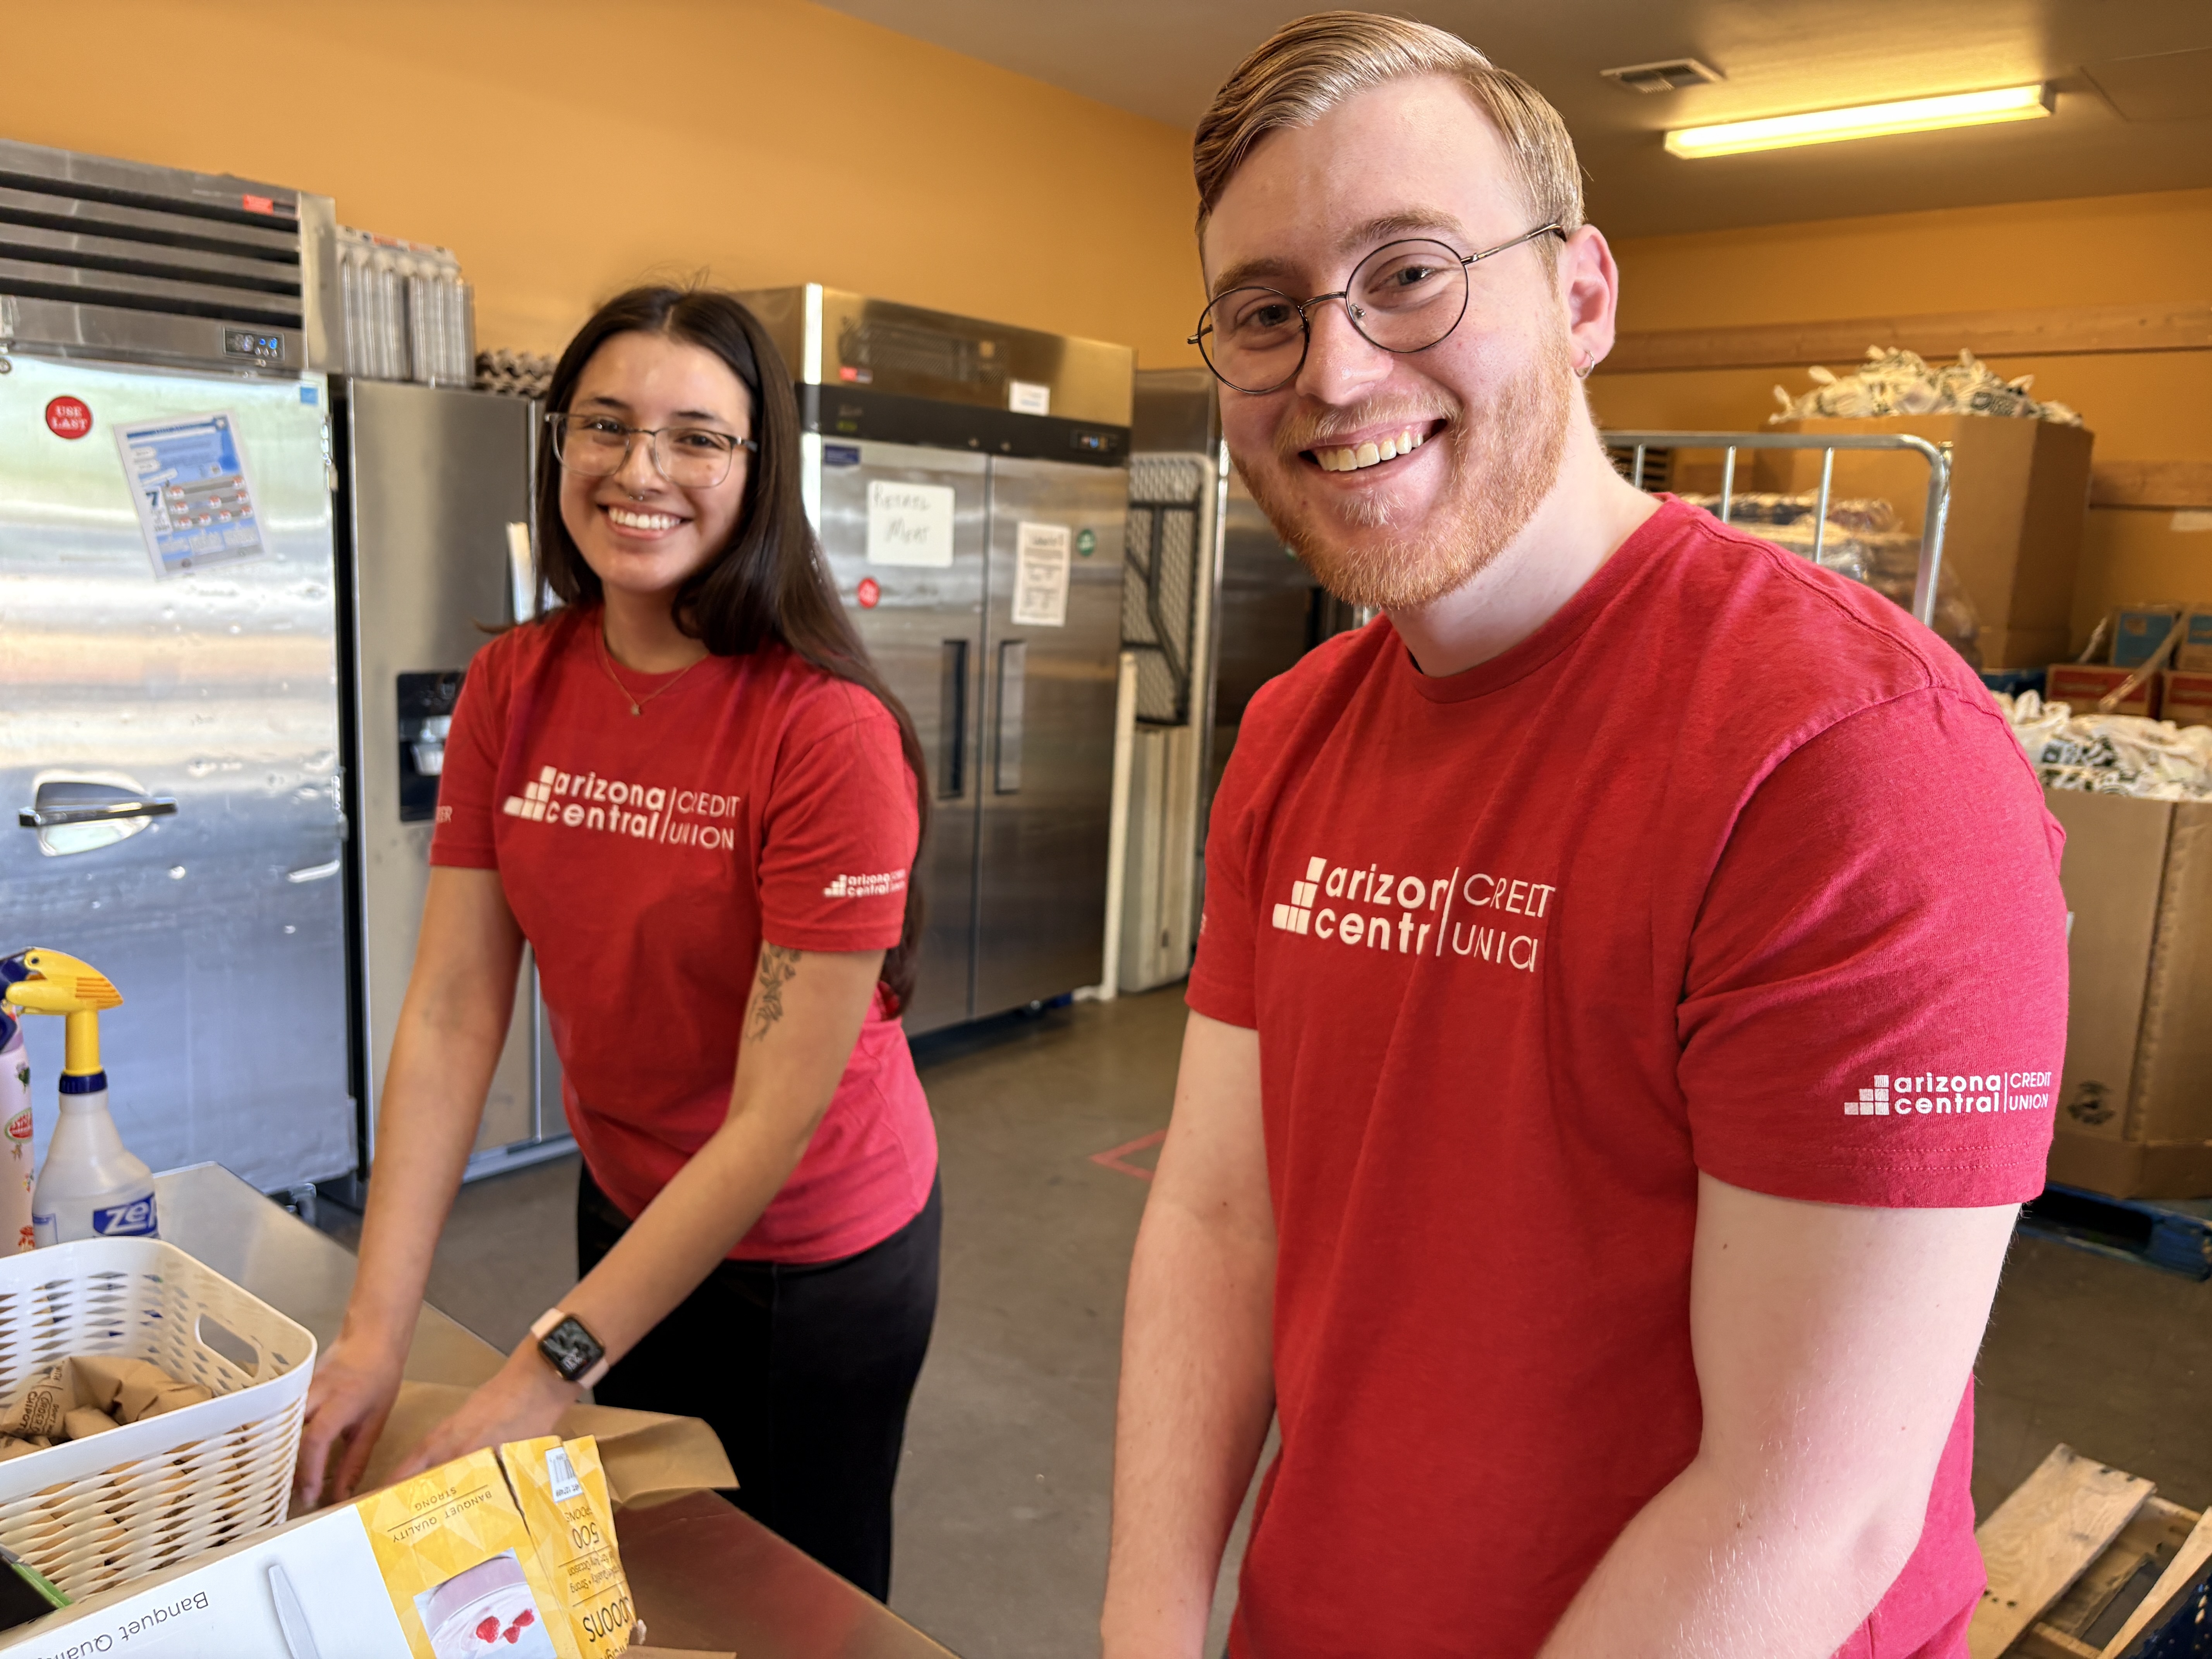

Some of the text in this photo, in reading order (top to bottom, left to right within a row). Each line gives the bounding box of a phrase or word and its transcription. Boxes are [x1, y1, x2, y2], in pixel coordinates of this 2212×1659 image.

[56, 405, 82, 417] USE
[51, 416, 88, 431] LAST
[145, 491, 160, 507] 7
[553, 771, 666, 812] arizona
[546, 801, 659, 839] central
[847, 881, 889, 898] central
[848, 873, 890, 886] arizona
[1894, 1072, 2052, 1093] arizona CREDIT
[1894, 1092, 2049, 1114] central UNION
[415, 1487, 457, 1511] STRONG
[393, 1491, 492, 1542] BANQUET QUALITY
[572, 1522, 599, 1549] 500
[568, 1561, 591, 1576] Occasion
[570, 1579, 589, 1593] Strong
[119, 1592, 209, 1641] Banquet
